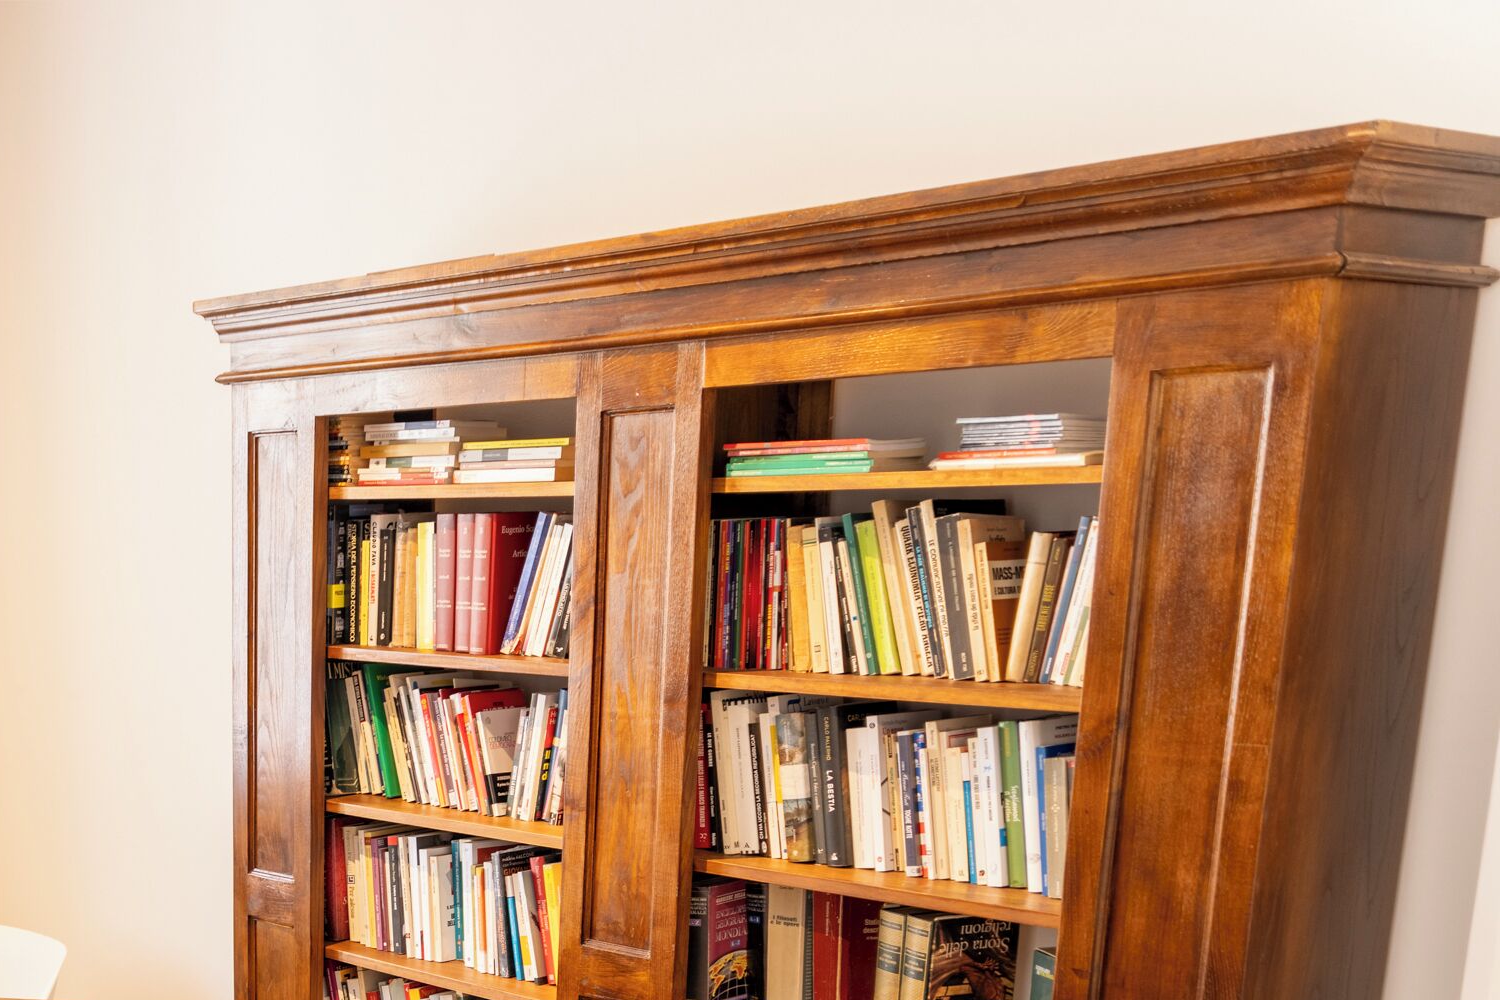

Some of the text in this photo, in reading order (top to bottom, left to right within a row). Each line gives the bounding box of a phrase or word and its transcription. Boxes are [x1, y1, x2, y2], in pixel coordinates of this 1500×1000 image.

[501, 525, 525, 535] Eugenio
[900, 525, 933, 668] QUARK ECONOMIA PIERO ANGELA
[750, 733, 758, 769] REPUBBLICA?
[756, 794, 760, 802] LA
[826, 770, 835, 813] LA BESTIA
[904, 809, 912, 824] TOGHE
[758, 822, 763, 830] HA
[905, 824, 913, 838] ROTTE
[960, 918, 1011, 938] religioni
[939, 934, 1010, 958] Storia delle
